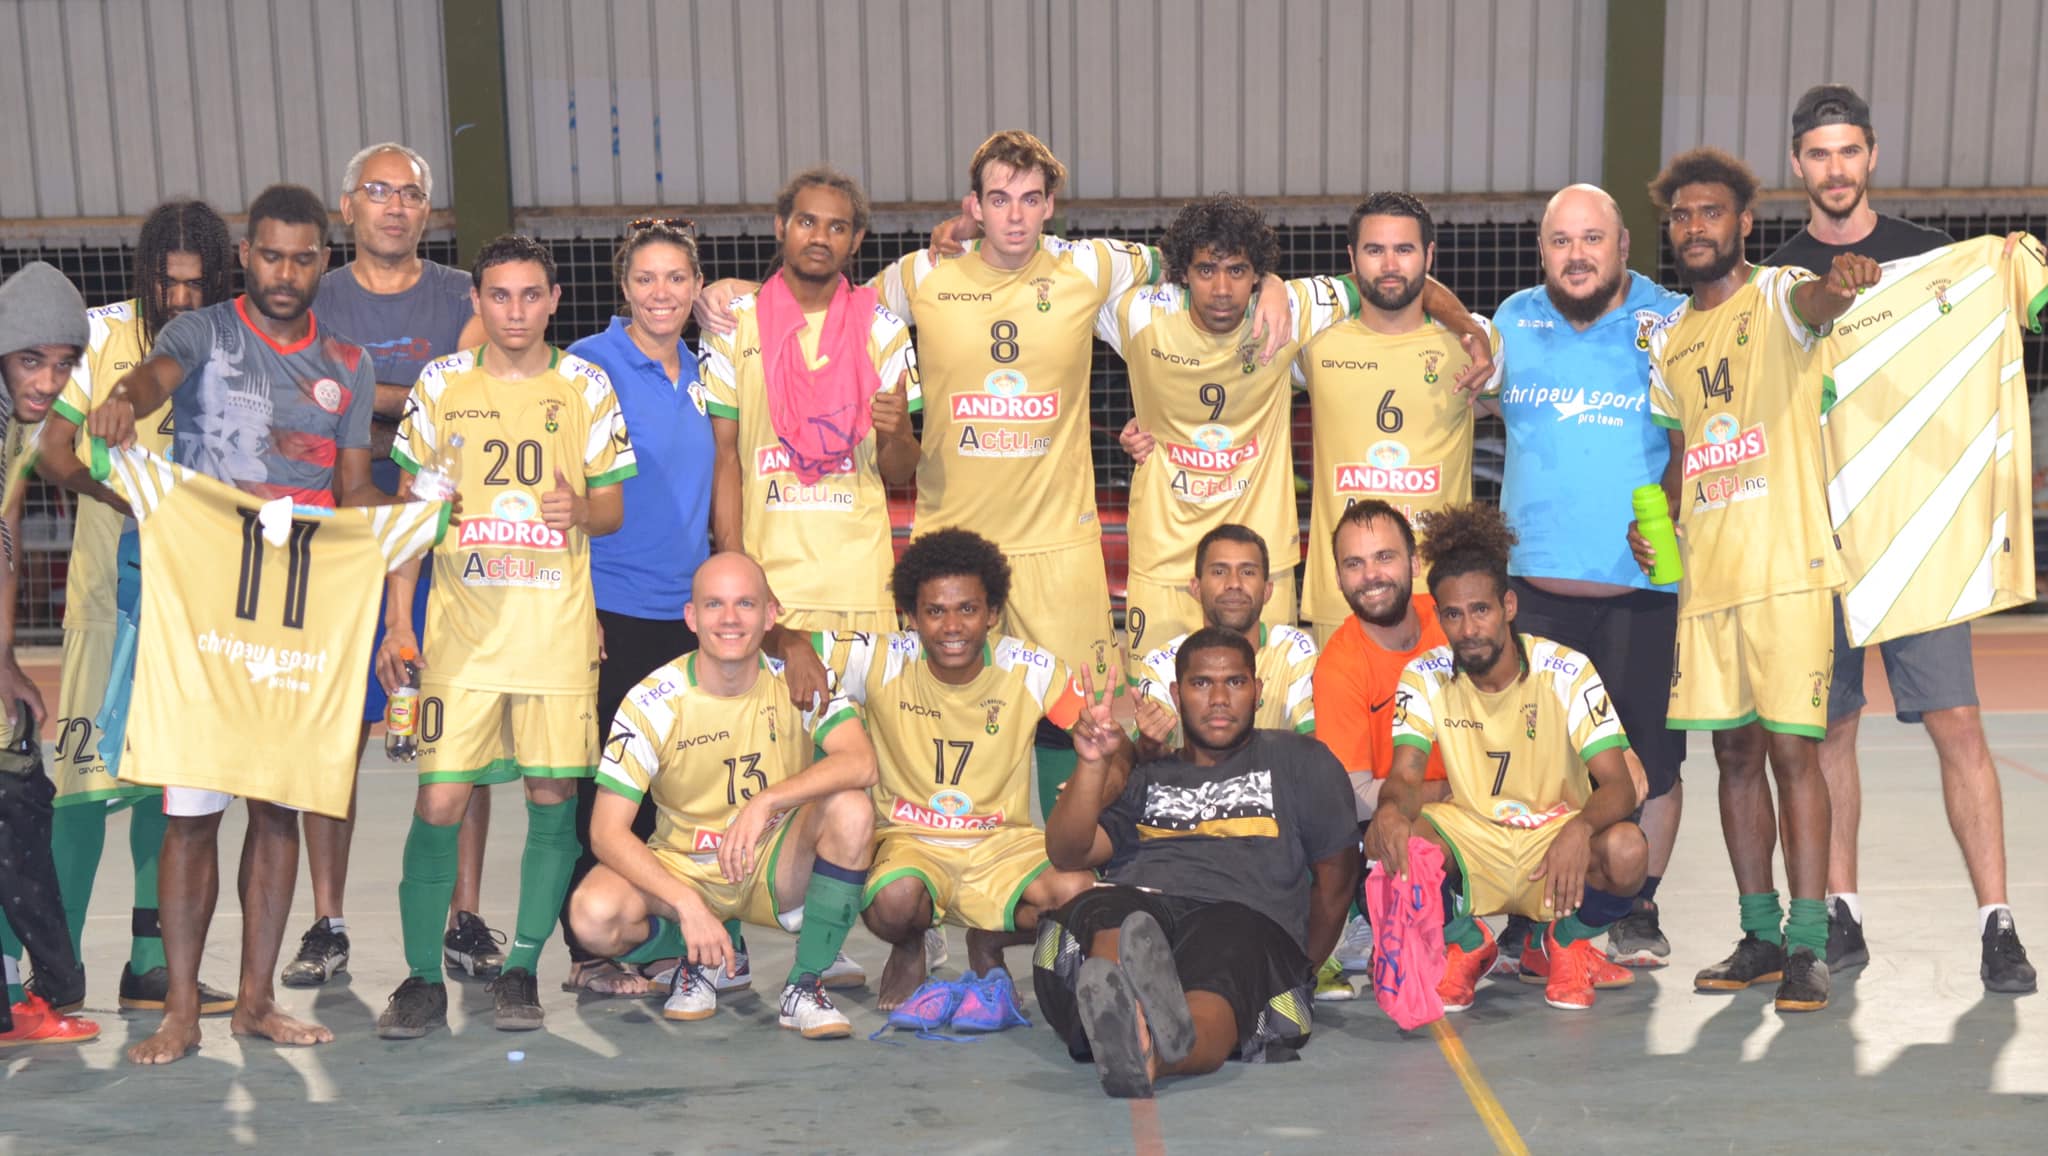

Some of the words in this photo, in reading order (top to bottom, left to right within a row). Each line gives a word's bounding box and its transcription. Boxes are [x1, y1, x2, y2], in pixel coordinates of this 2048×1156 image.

[936, 293, 992, 302] GIVOVA
[1839, 310, 1894, 336] GIVOVA
[990, 320, 1020, 364] 8
[1321, 359, 1379, 371] GIVOVA
[1697, 357, 1734, 409] 14
[956, 397, 1055, 418] ANDROS
[1199, 383, 1226, 421] 9
[1376, 389, 1404, 433] 6
[1503, 383, 1574, 409] chripau
[1588, 391, 1646, 412] sport
[444, 409, 500, 421] GIVOVA
[1577, 413, 1596, 425] pro
[1598, 414, 1624, 427] team
[483, 439, 543, 487] 20
[1339, 469, 1436, 491] ANDROS
[461, 520, 564, 546] ANDROS
[462, 552, 561, 583] Actu.nc
[1129, 606, 1146, 649] 9
[197, 629, 265, 664] chripau
[278, 648, 328, 672] sport
[1022, 649, 1048, 668] BCI
[1552, 657, 1577, 677] BCI
[648, 681, 675, 701] BCI
[79, 766, 105, 775] GIVO
[932, 738, 974, 785] 17
[1486, 752, 1511, 796] 7
[723, 753, 768, 805] 13
